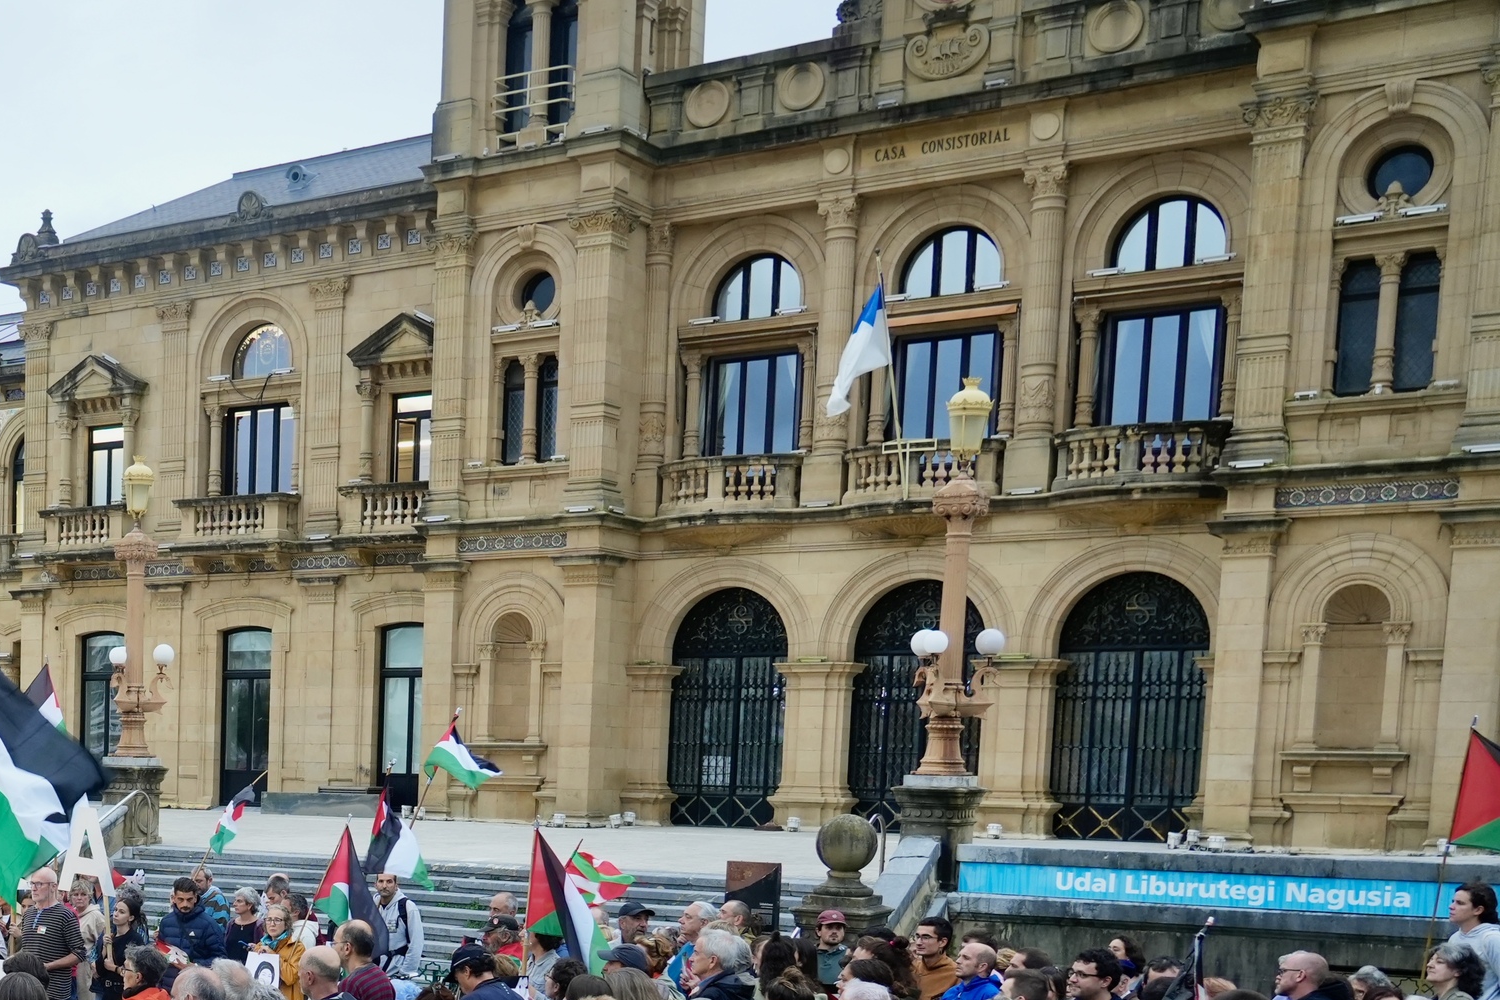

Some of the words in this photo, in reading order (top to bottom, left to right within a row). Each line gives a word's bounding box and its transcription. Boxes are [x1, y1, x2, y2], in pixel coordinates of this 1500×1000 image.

[874, 147, 906, 162] CASA
[921, 128, 1010, 154] CONSISTORIAL
[1055, 871, 1116, 893] Udal
[1125, 873, 1275, 906] Liburutegi
[1285, 882, 1411, 910] Nagusia
